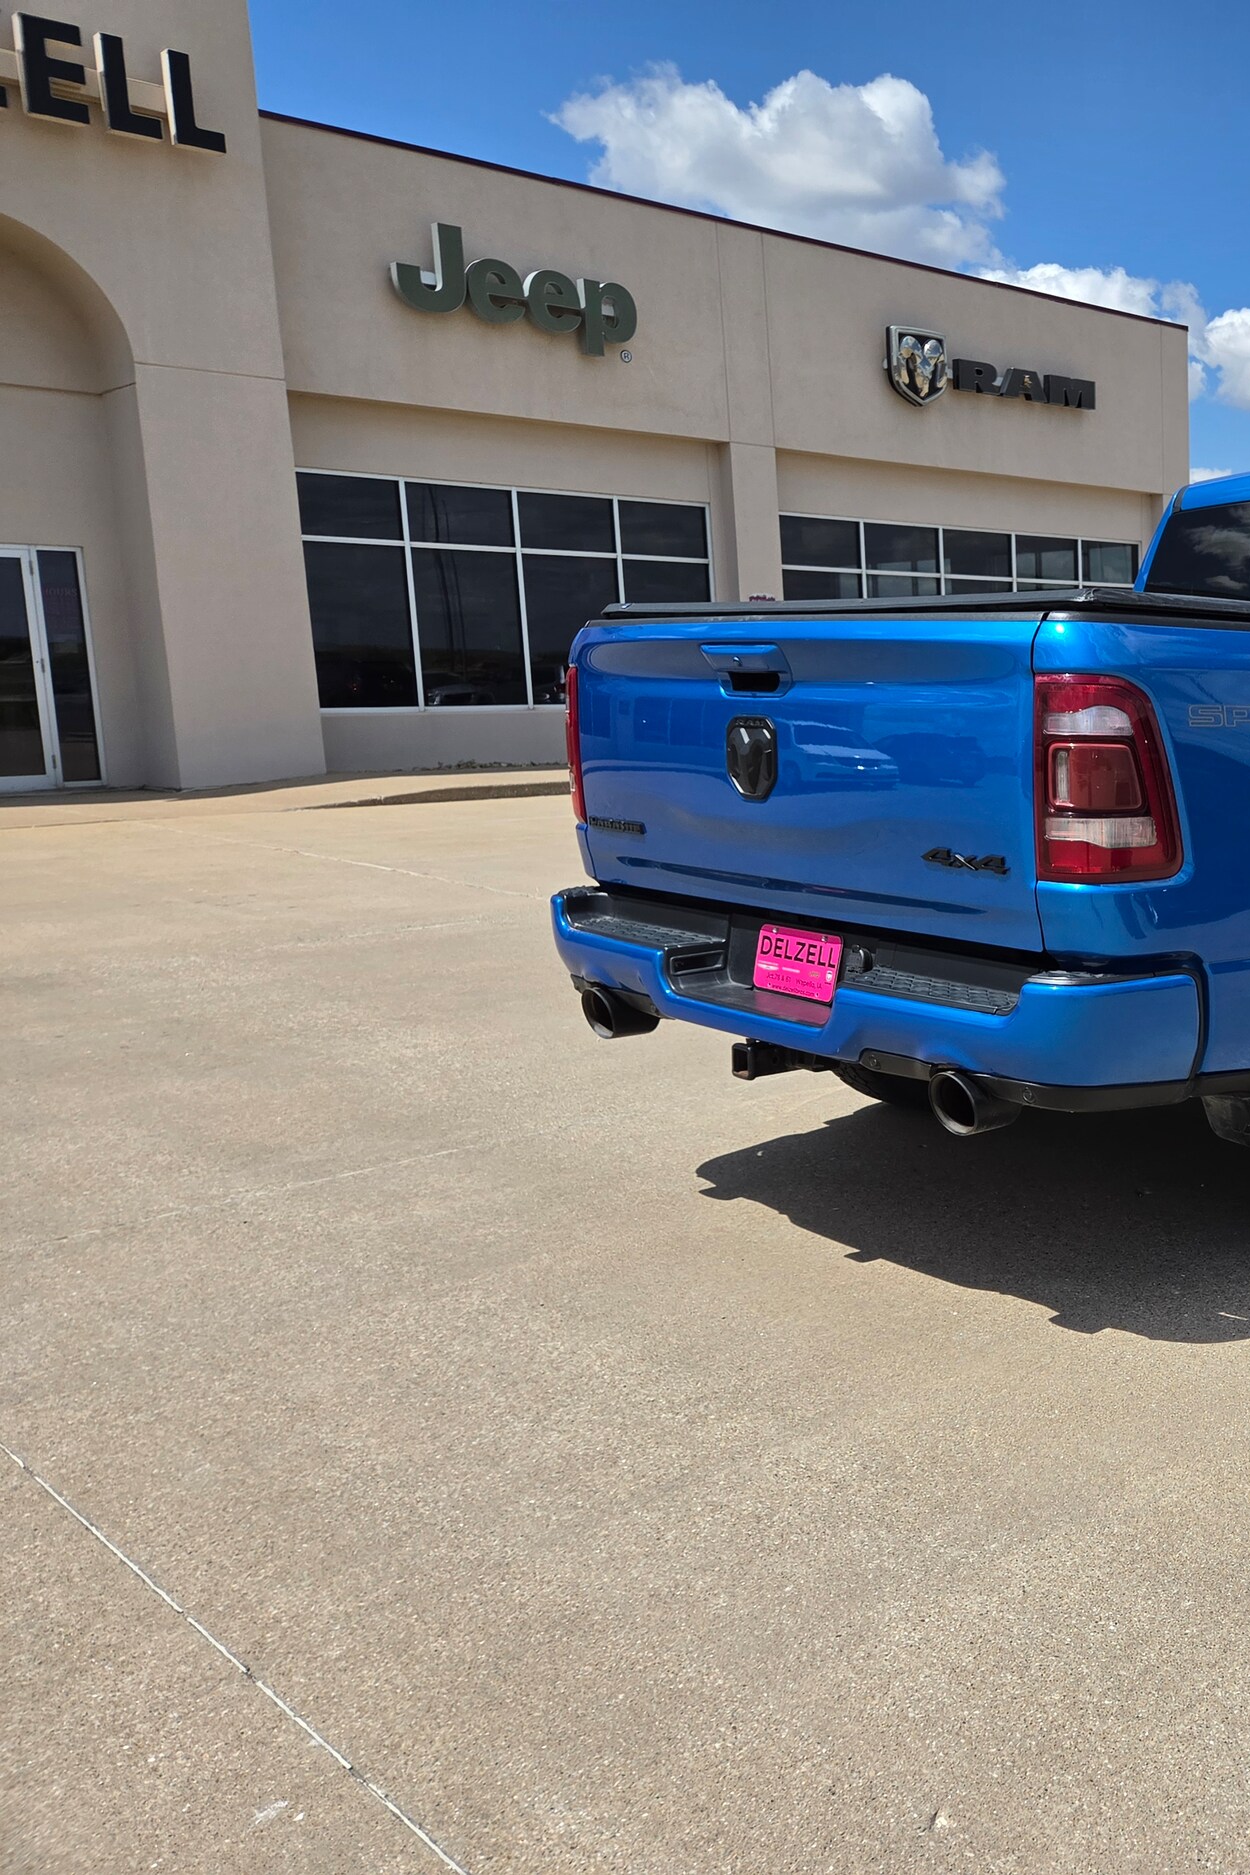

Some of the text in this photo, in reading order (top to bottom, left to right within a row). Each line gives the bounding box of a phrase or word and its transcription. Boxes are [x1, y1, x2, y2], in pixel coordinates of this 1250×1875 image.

[0, 10, 227, 156] ELL
[390, 222, 637, 357] Jeep
[952, 358, 1096, 410] RAM
[760, 935, 836, 969] DELZELL
